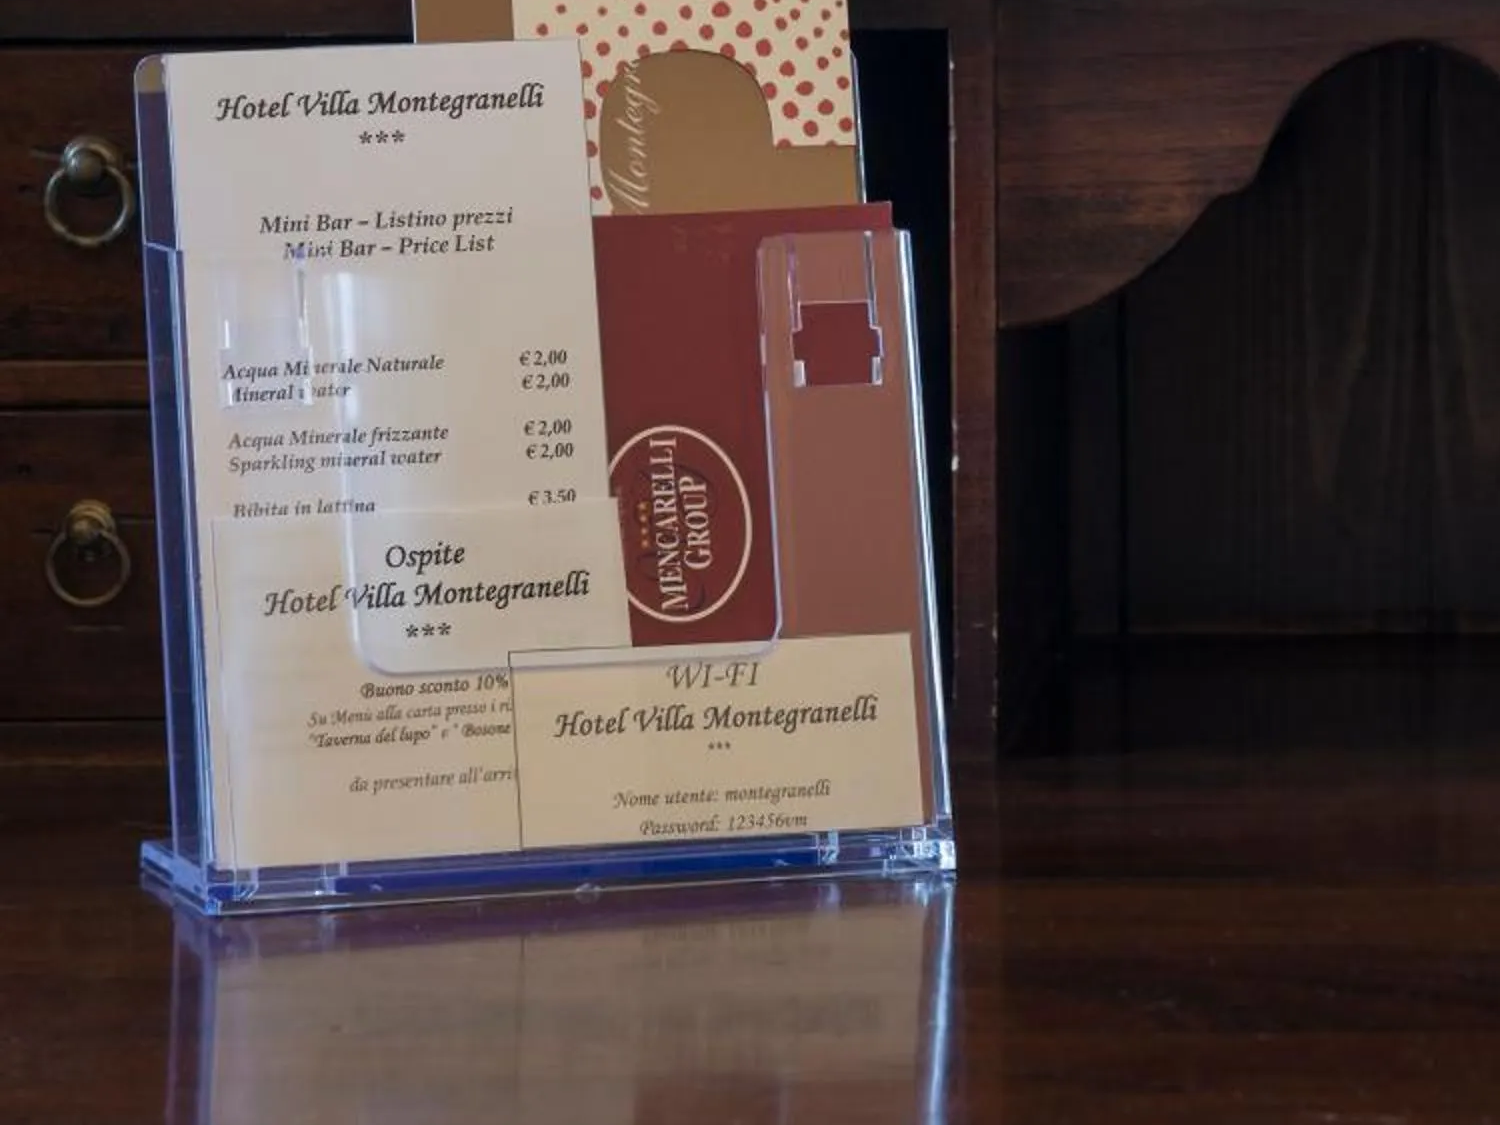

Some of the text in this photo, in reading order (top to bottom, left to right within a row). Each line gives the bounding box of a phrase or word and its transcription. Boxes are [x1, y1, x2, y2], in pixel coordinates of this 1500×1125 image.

[216, 82, 545, 121] Hotel Villa Montegranelli
[259, 214, 310, 235] Mini
[316, 214, 353, 232] Bar
[374, 208, 447, 230] Listino
[450, 207, 514, 231] prezzi
[340, 239, 376, 258] Bar
[399, 236, 450, 256] Price
[455, 234, 496, 254] List
[222, 364, 278, 381] Acqua
[366, 355, 446, 374] Naturale
[228, 425, 449, 452] Acqua Minerale frizzante
[228, 455, 315, 476] Sparkling
[390, 450, 443, 466] water
[294, 500, 312, 516] in
[650, 437, 689, 611] MENCARELLI
[679, 476, 714, 570] GROUP
[385, 541, 466, 575] Ospite
[263, 570, 591, 618] Hotel Villa Montegranelli
[360, 673, 509, 699] Buono sconto 10%
[666, 661, 760, 690] WI-FI
[376, 704, 402, 722] alla
[405, 703, 442, 720] carta
[444, 703, 487, 721] presso
[552, 694, 879, 738] Hotel Villa Montegranelli
[375, 727, 398, 744] del
[349, 775, 369, 793] da
[373, 773, 456, 795] presentare
[613, 779, 831, 810] Nome utente: montegranelli
[640, 815, 720, 836] Password:
